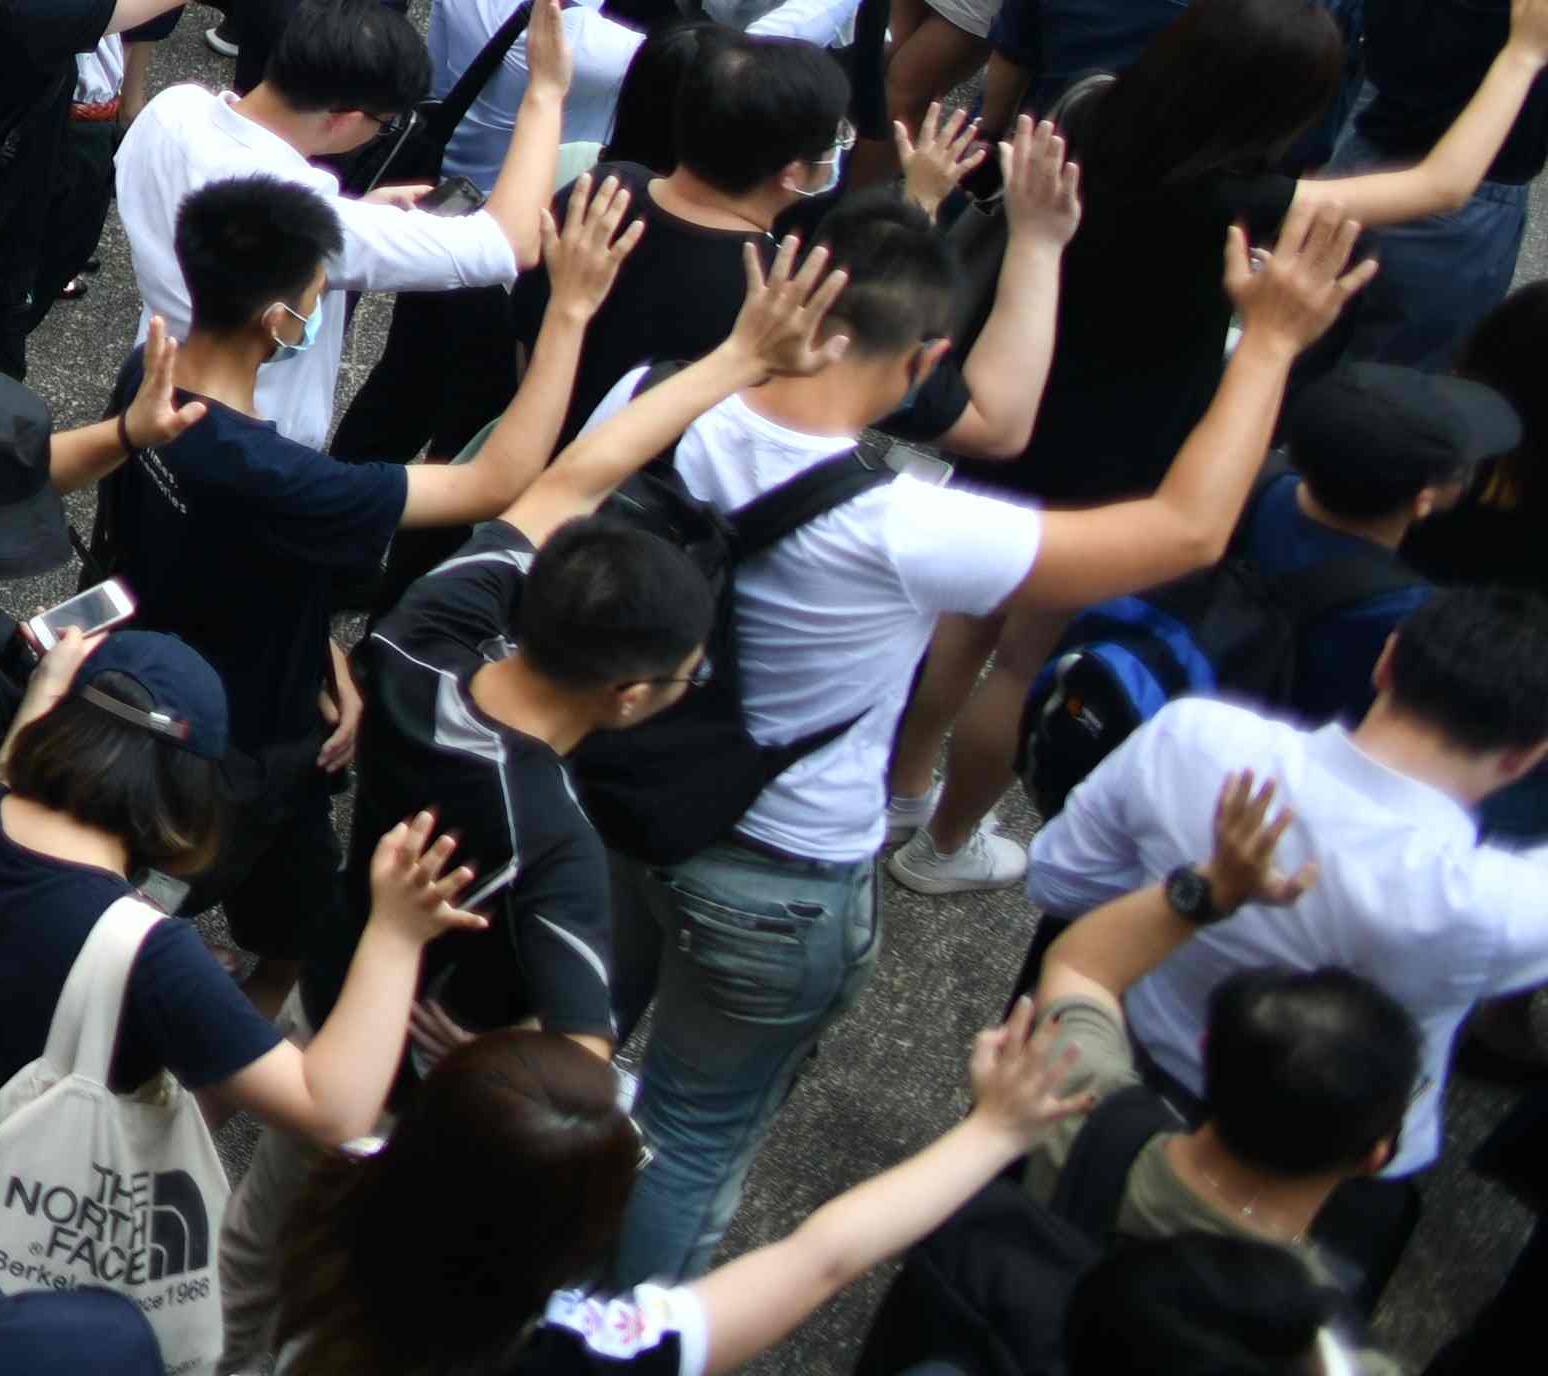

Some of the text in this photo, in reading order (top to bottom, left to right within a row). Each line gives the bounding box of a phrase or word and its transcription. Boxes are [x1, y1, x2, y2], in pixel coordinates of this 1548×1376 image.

[4, 1175, 147, 1250] NORTH
[92, 1161, 150, 1208] THE
[46, 1226, 147, 1285] FACE
